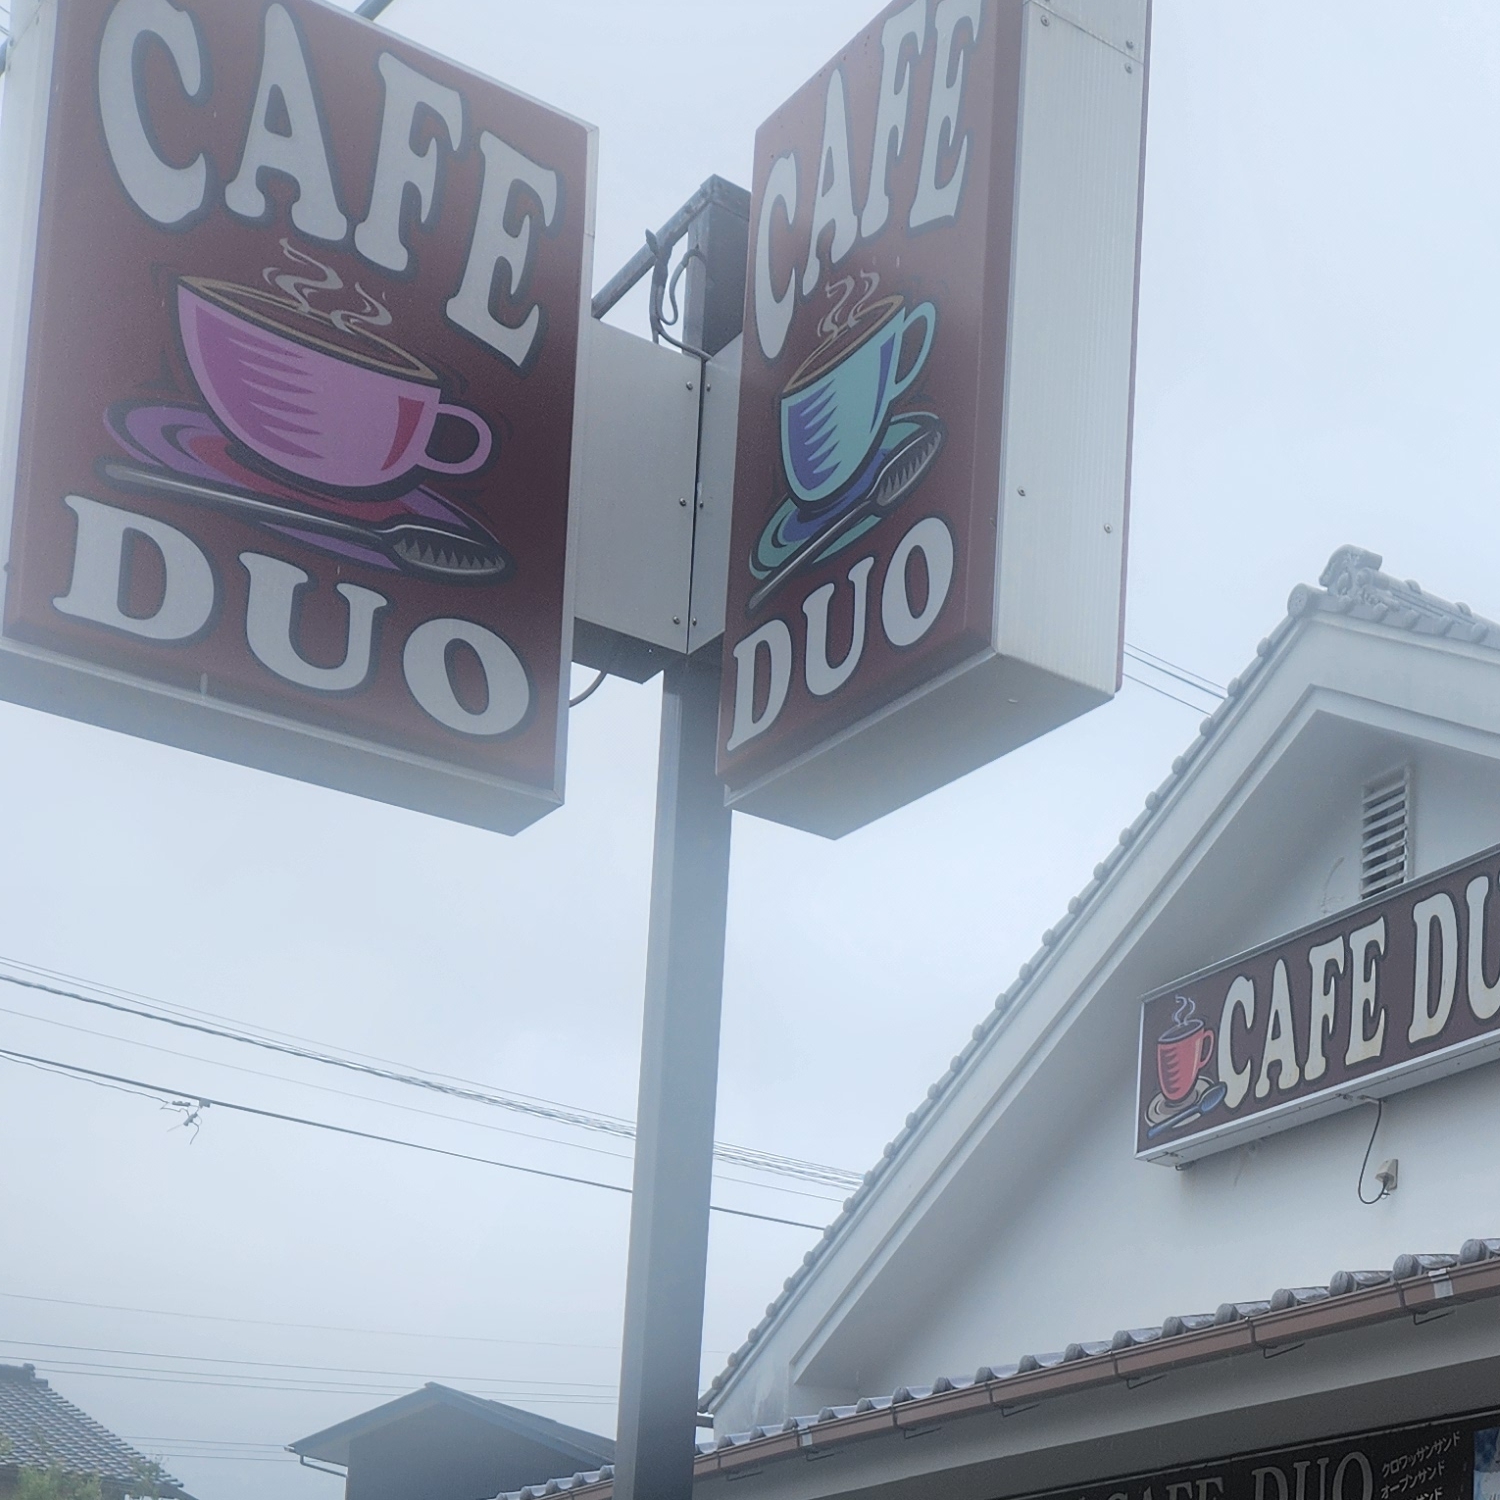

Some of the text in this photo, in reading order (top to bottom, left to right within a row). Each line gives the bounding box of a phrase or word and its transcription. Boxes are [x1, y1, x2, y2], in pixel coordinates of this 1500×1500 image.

[98, 0, 557, 367] CAFE
[755, 0, 982, 359] CAFE
[53, 495, 531, 736] DUO
[726, 518, 954, 753] DUO
[1218, 916, 1386, 1109] CAFE
[1381, 1460, 1446, 1500] オープンサンド
[1382, 1431, 1461, 1478] クロワッサンサンド
